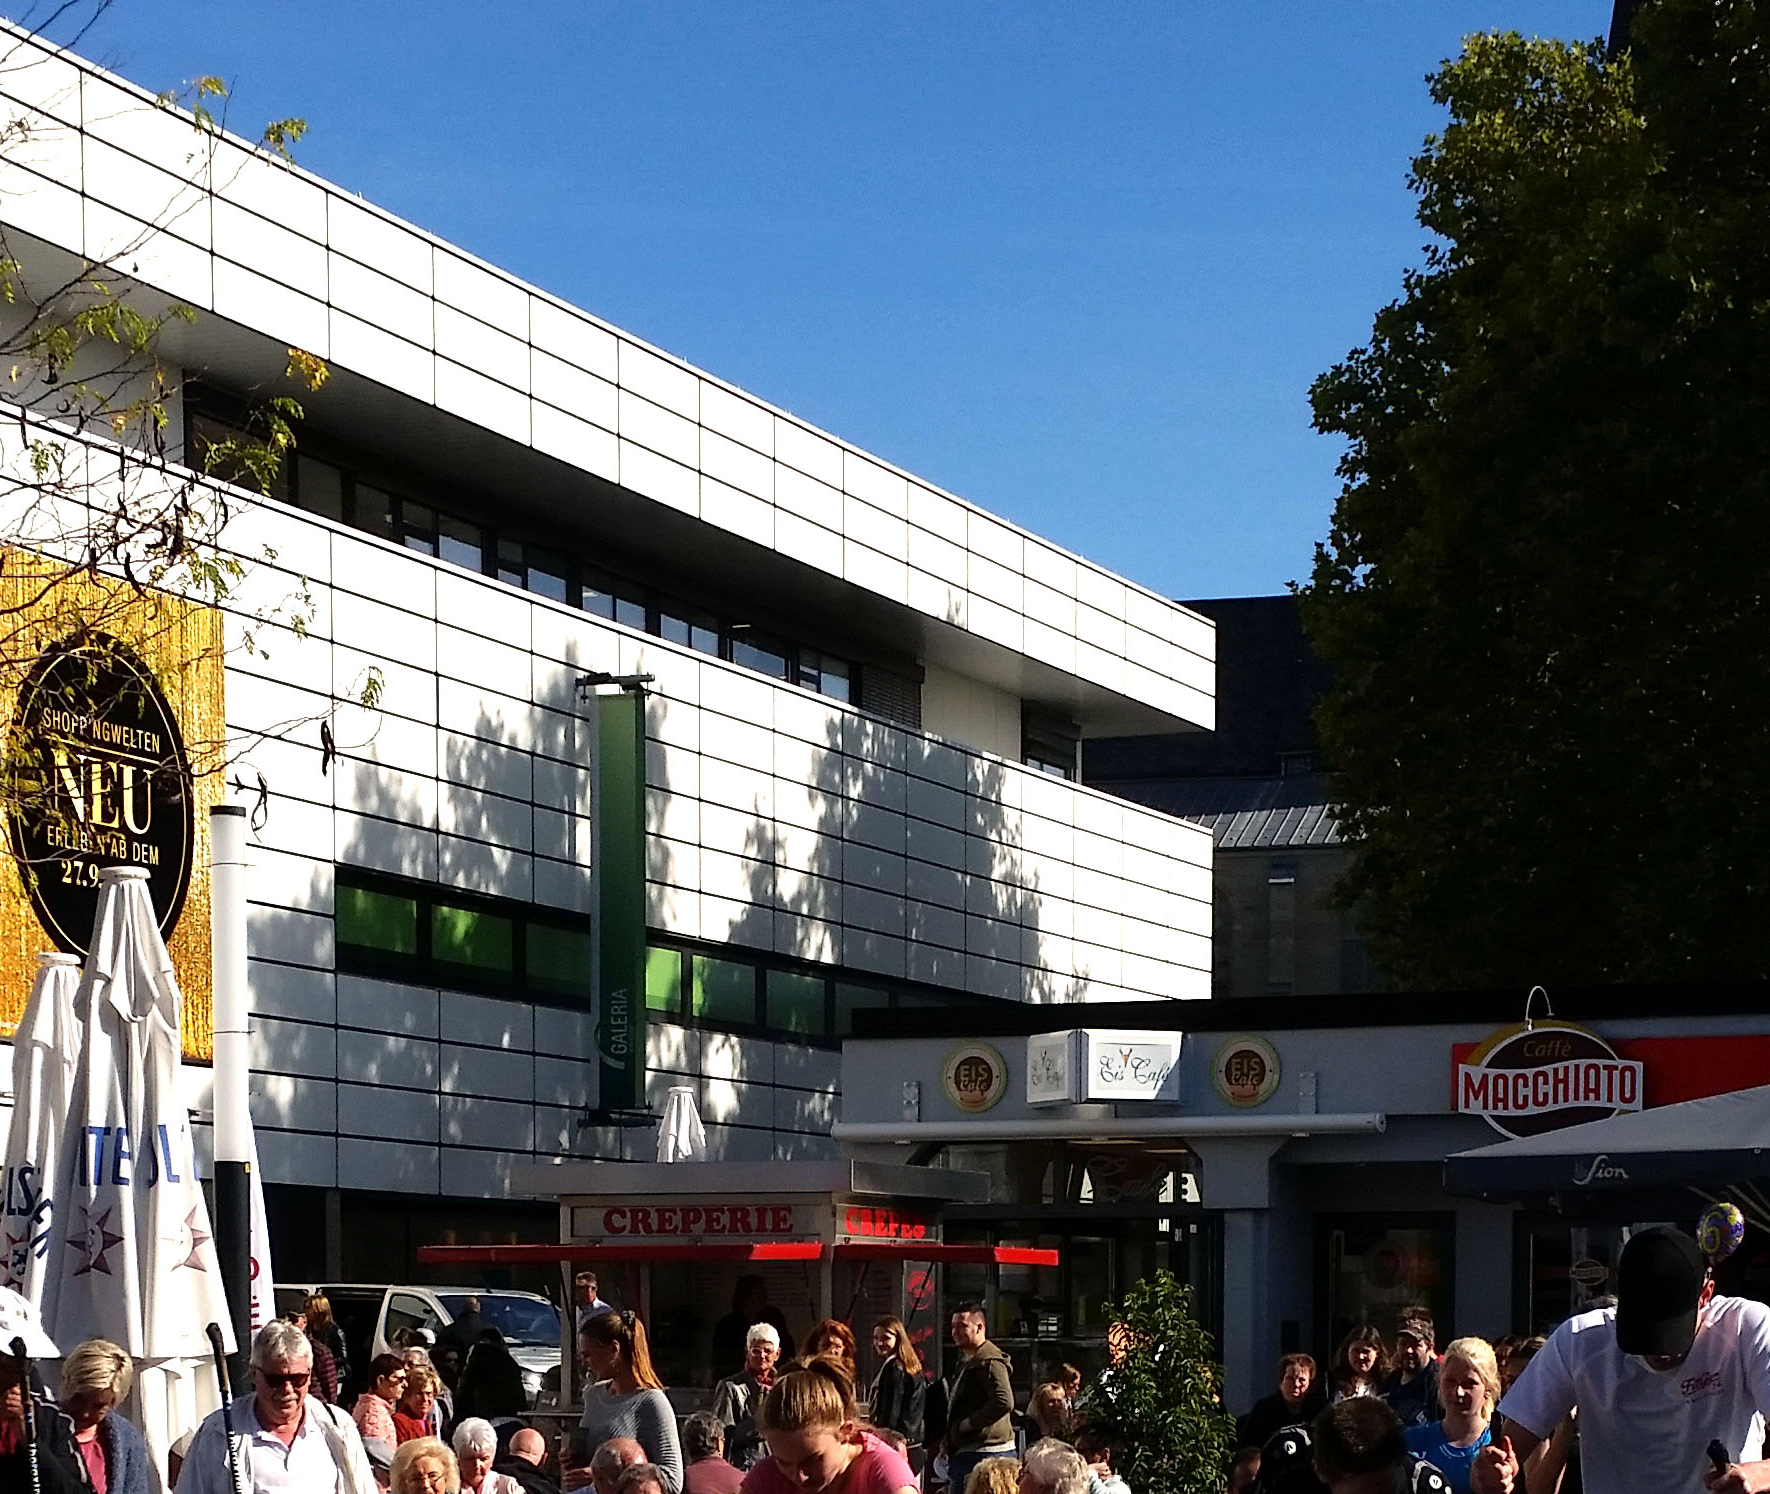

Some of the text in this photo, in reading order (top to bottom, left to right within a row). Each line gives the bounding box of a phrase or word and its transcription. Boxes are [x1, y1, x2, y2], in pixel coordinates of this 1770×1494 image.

[42, 706, 161, 754] SHOPPNGWELTEN
[50, 747, 154, 835] NEU
[109, 839, 127, 860] AB
[132, 841, 160, 866] DEM
[610, 988, 628, 1055] GALERIA
[1522, 1038, 1573, 1058] Caffè
[959, 1064, 990, 1081] EIS
[1099, 1055, 1125, 1083] Eis
[1231, 1058, 1260, 1074] EIS
[1463, 1062, 1638, 1112] MACCHIATO
[1572, 1153, 1629, 1187] Sion
[603, 1205, 795, 1235] CREPERIE
[845, 1207, 927, 1239] CREPES
